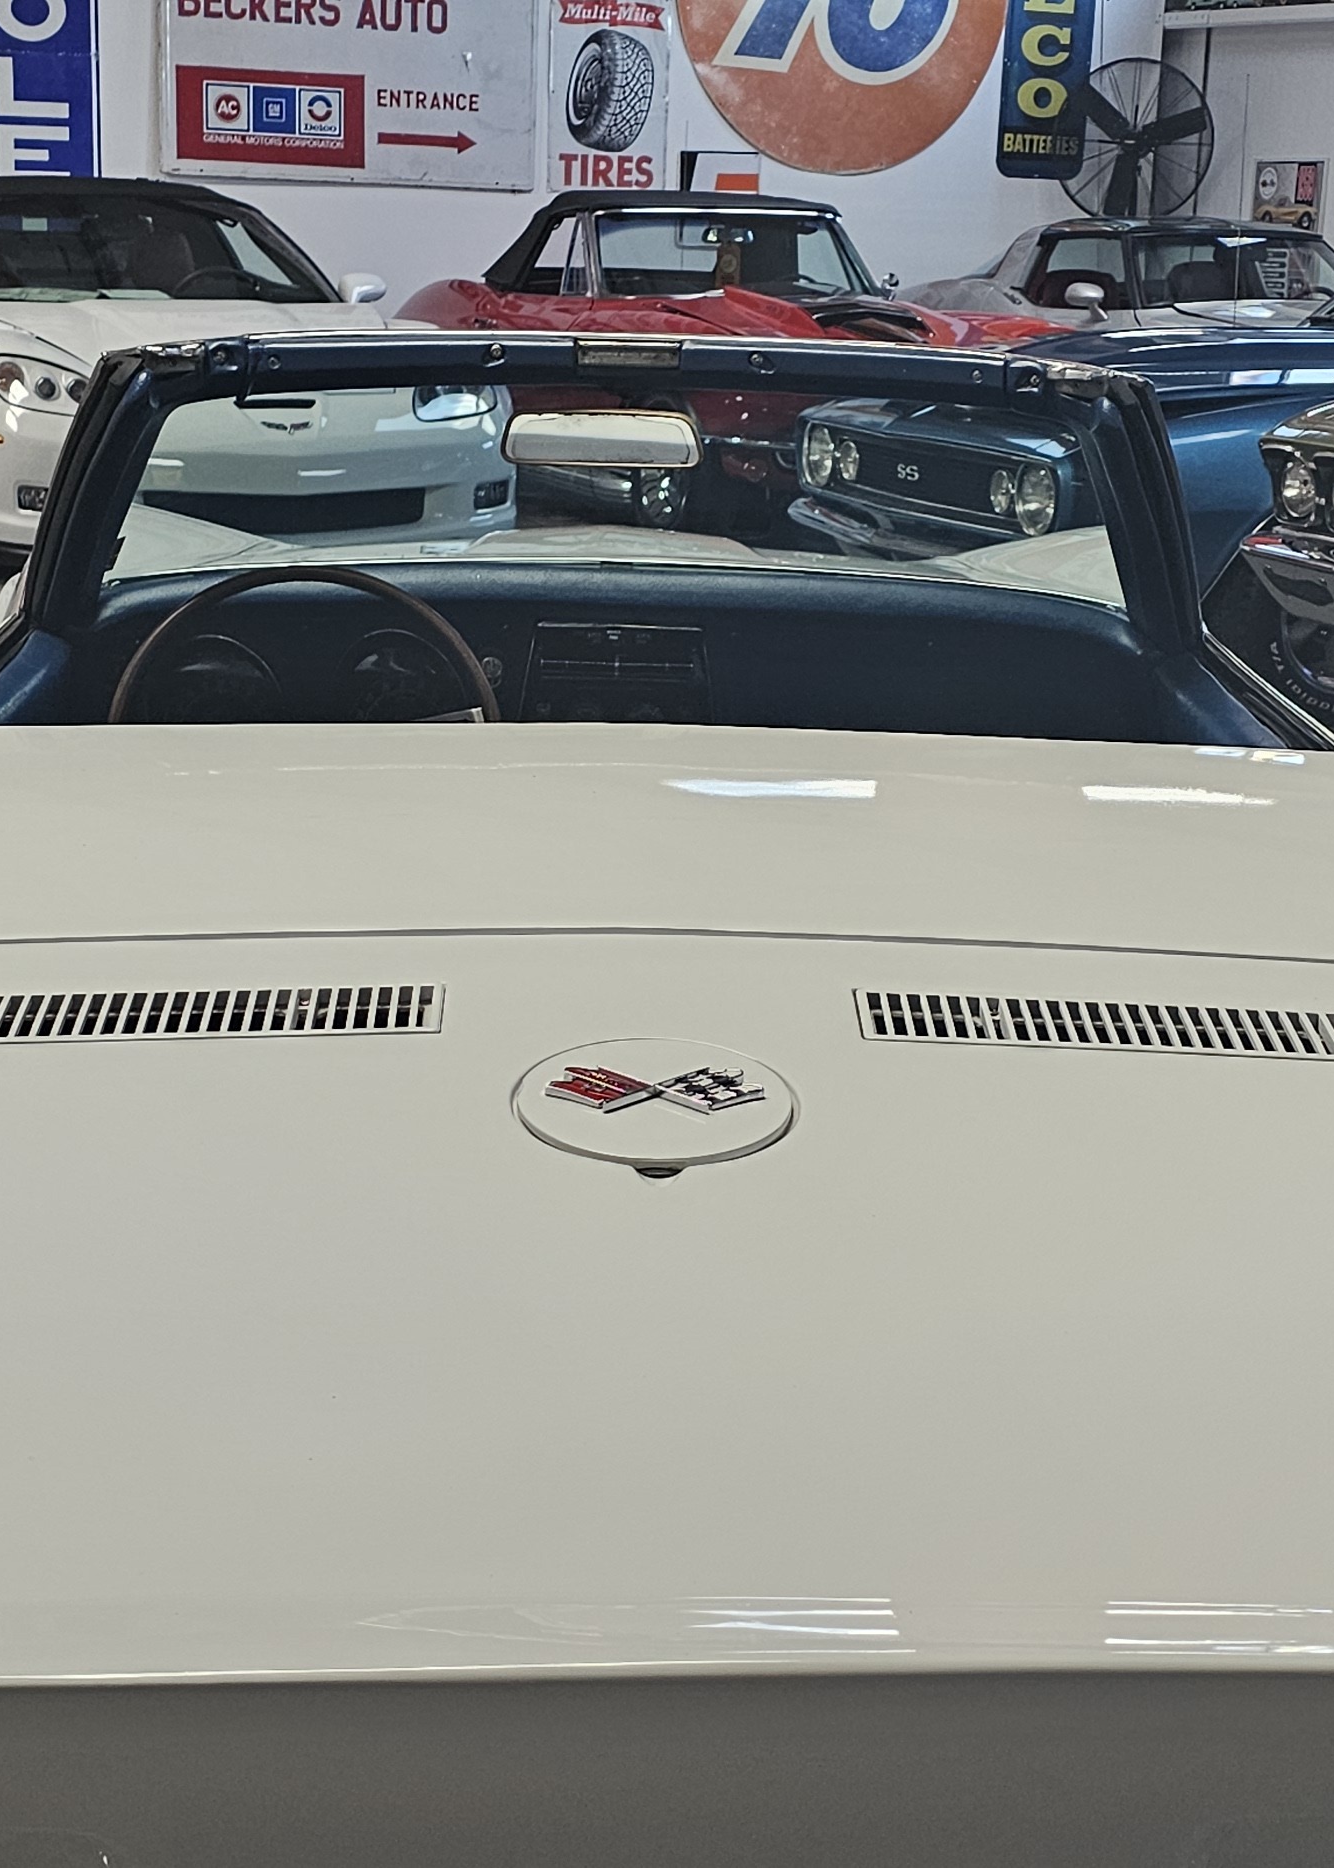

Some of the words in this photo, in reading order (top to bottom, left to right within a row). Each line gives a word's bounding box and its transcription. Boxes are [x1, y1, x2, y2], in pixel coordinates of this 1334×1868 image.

[177, 0, 340, 28] BECKERS
[356, 0, 448, 34] AUTO
[563, 2, 657, 23] Multi-Mile
[217, 100, 238, 114] AC
[377, 88, 479, 112] ENTRANCE
[303, 123, 337, 133] Delco
[203, 134, 244, 144] GENERAL
[246, 136, 283, 146] MOTORS
[284, 138, 344, 149] CORPORATION
[559, 153, 654, 189] TIRES
[897, 463, 919, 481] SS
